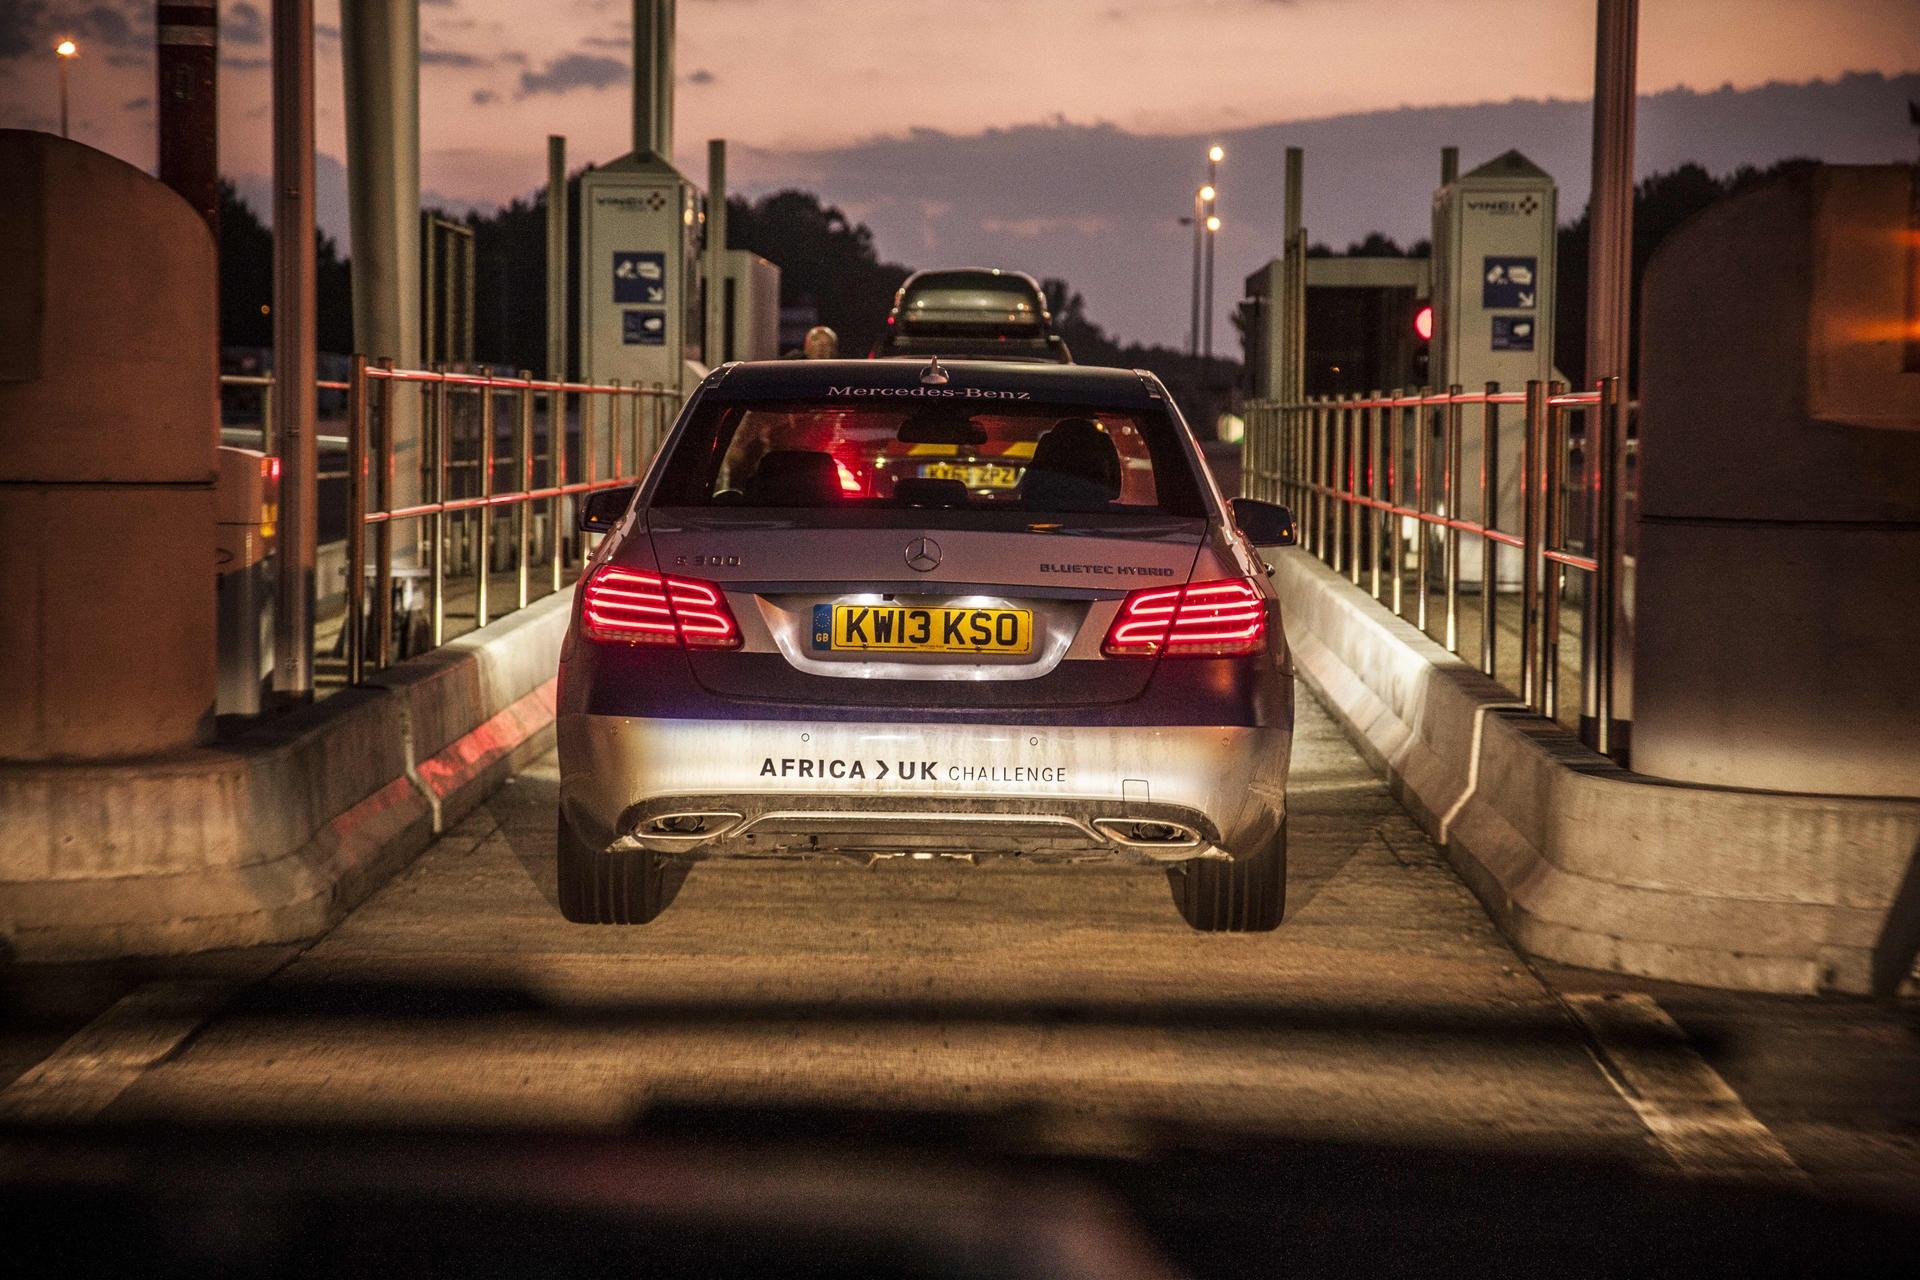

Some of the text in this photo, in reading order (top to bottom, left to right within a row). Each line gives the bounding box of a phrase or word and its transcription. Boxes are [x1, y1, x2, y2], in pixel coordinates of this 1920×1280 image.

[826, 385, 1032, 400] Mercedes-Benz
[693, 555, 741, 567] 300
[1039, 563, 1175, 577] BLUETEC HYBRID
[846, 609, 1019, 646] KW13 KSO
[815, 632, 829, 643] GB
[759, 757, 1067, 783] AFRICA UK CHALLENGE
